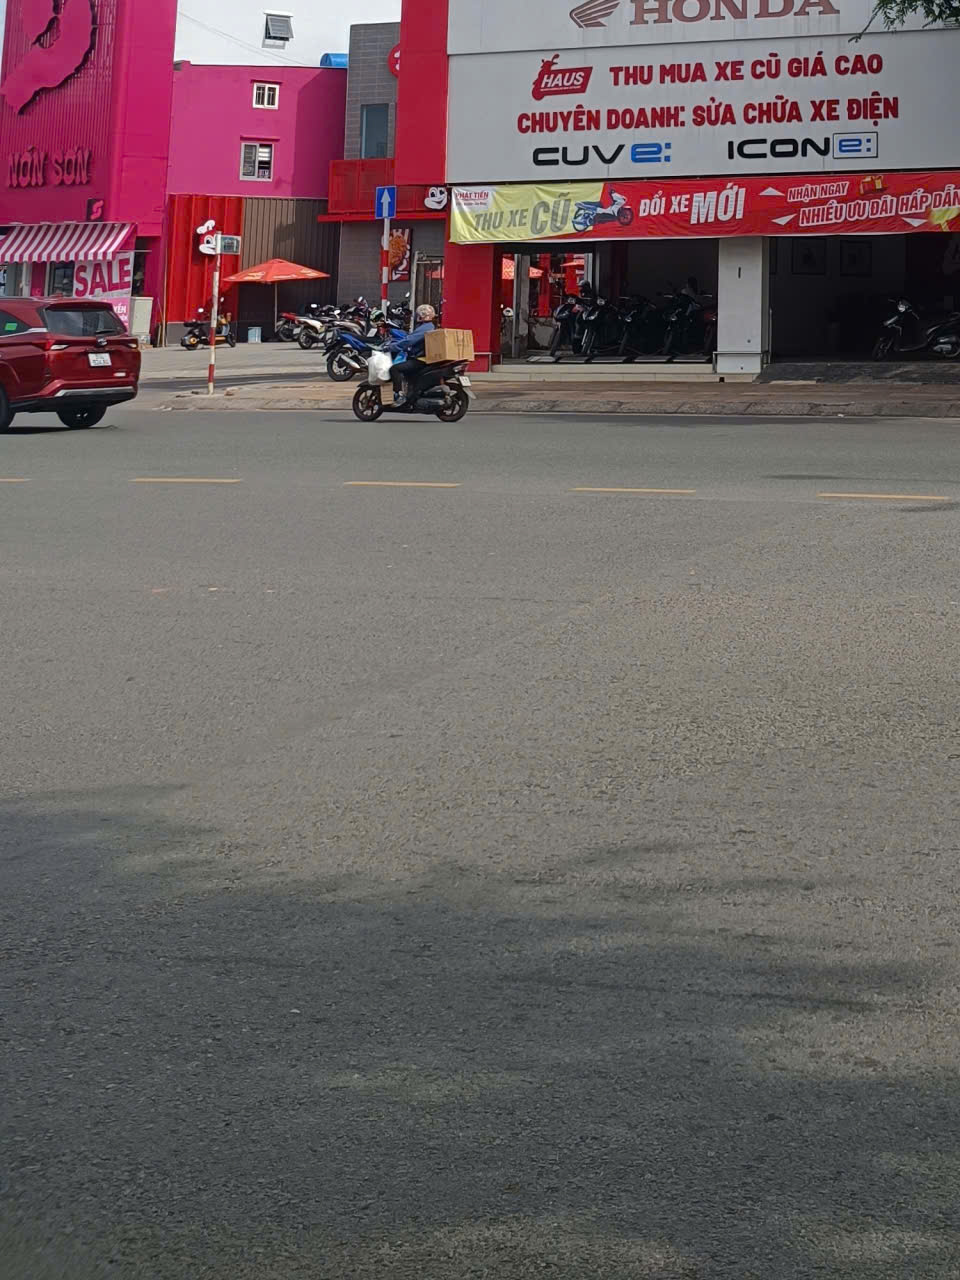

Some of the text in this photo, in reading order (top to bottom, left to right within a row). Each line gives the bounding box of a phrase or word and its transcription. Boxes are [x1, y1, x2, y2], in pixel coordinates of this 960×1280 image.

[541, 71, 585, 88] HAUS
[609, 51, 883, 86] THU MUA XE CŨ GIÁ CAO
[517, 91, 899, 134] CHUYÊN DOANH: SỬA CHỮA XE ĐIỆN
[8, 145, 47, 188] NÓN
[532, 143, 626, 166] CUV
[728, 137, 831, 160] ICON
[474, 182, 746, 235] THU XE CŨ ĐỔI XE MỚI
[787, 182, 849, 204] NHẬN NGAY
[799, 200, 848, 227] NHIỀU
[848, 201, 869, 221] ƯU
[869, 197, 896, 218] ĐÃI
[899, 189, 932, 215] HẤP
[74, 258, 132, 298] SALE
